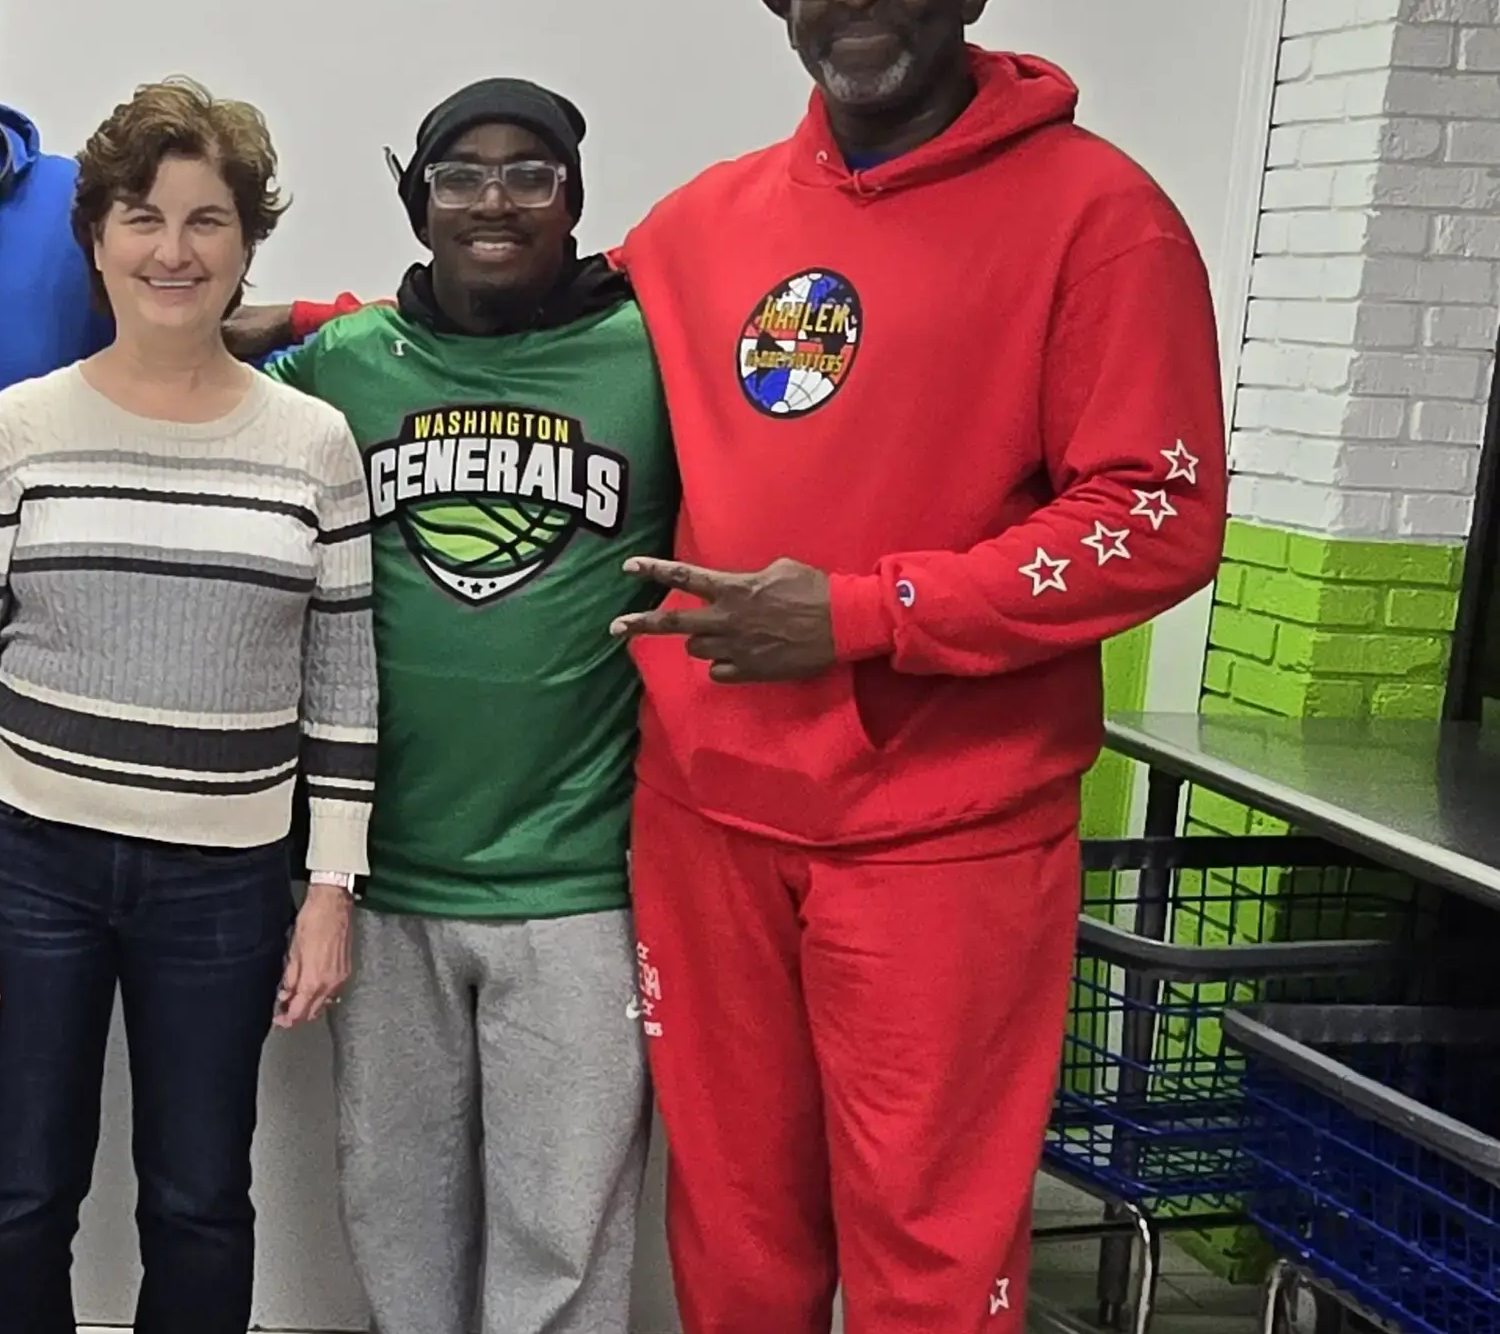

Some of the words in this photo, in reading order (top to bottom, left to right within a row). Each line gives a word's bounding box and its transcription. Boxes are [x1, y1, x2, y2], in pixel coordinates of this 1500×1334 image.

[759, 294, 851, 334] HARLEM
[414, 409, 570, 444] WASHINGTON
[369, 437, 622, 529] GENERALS
